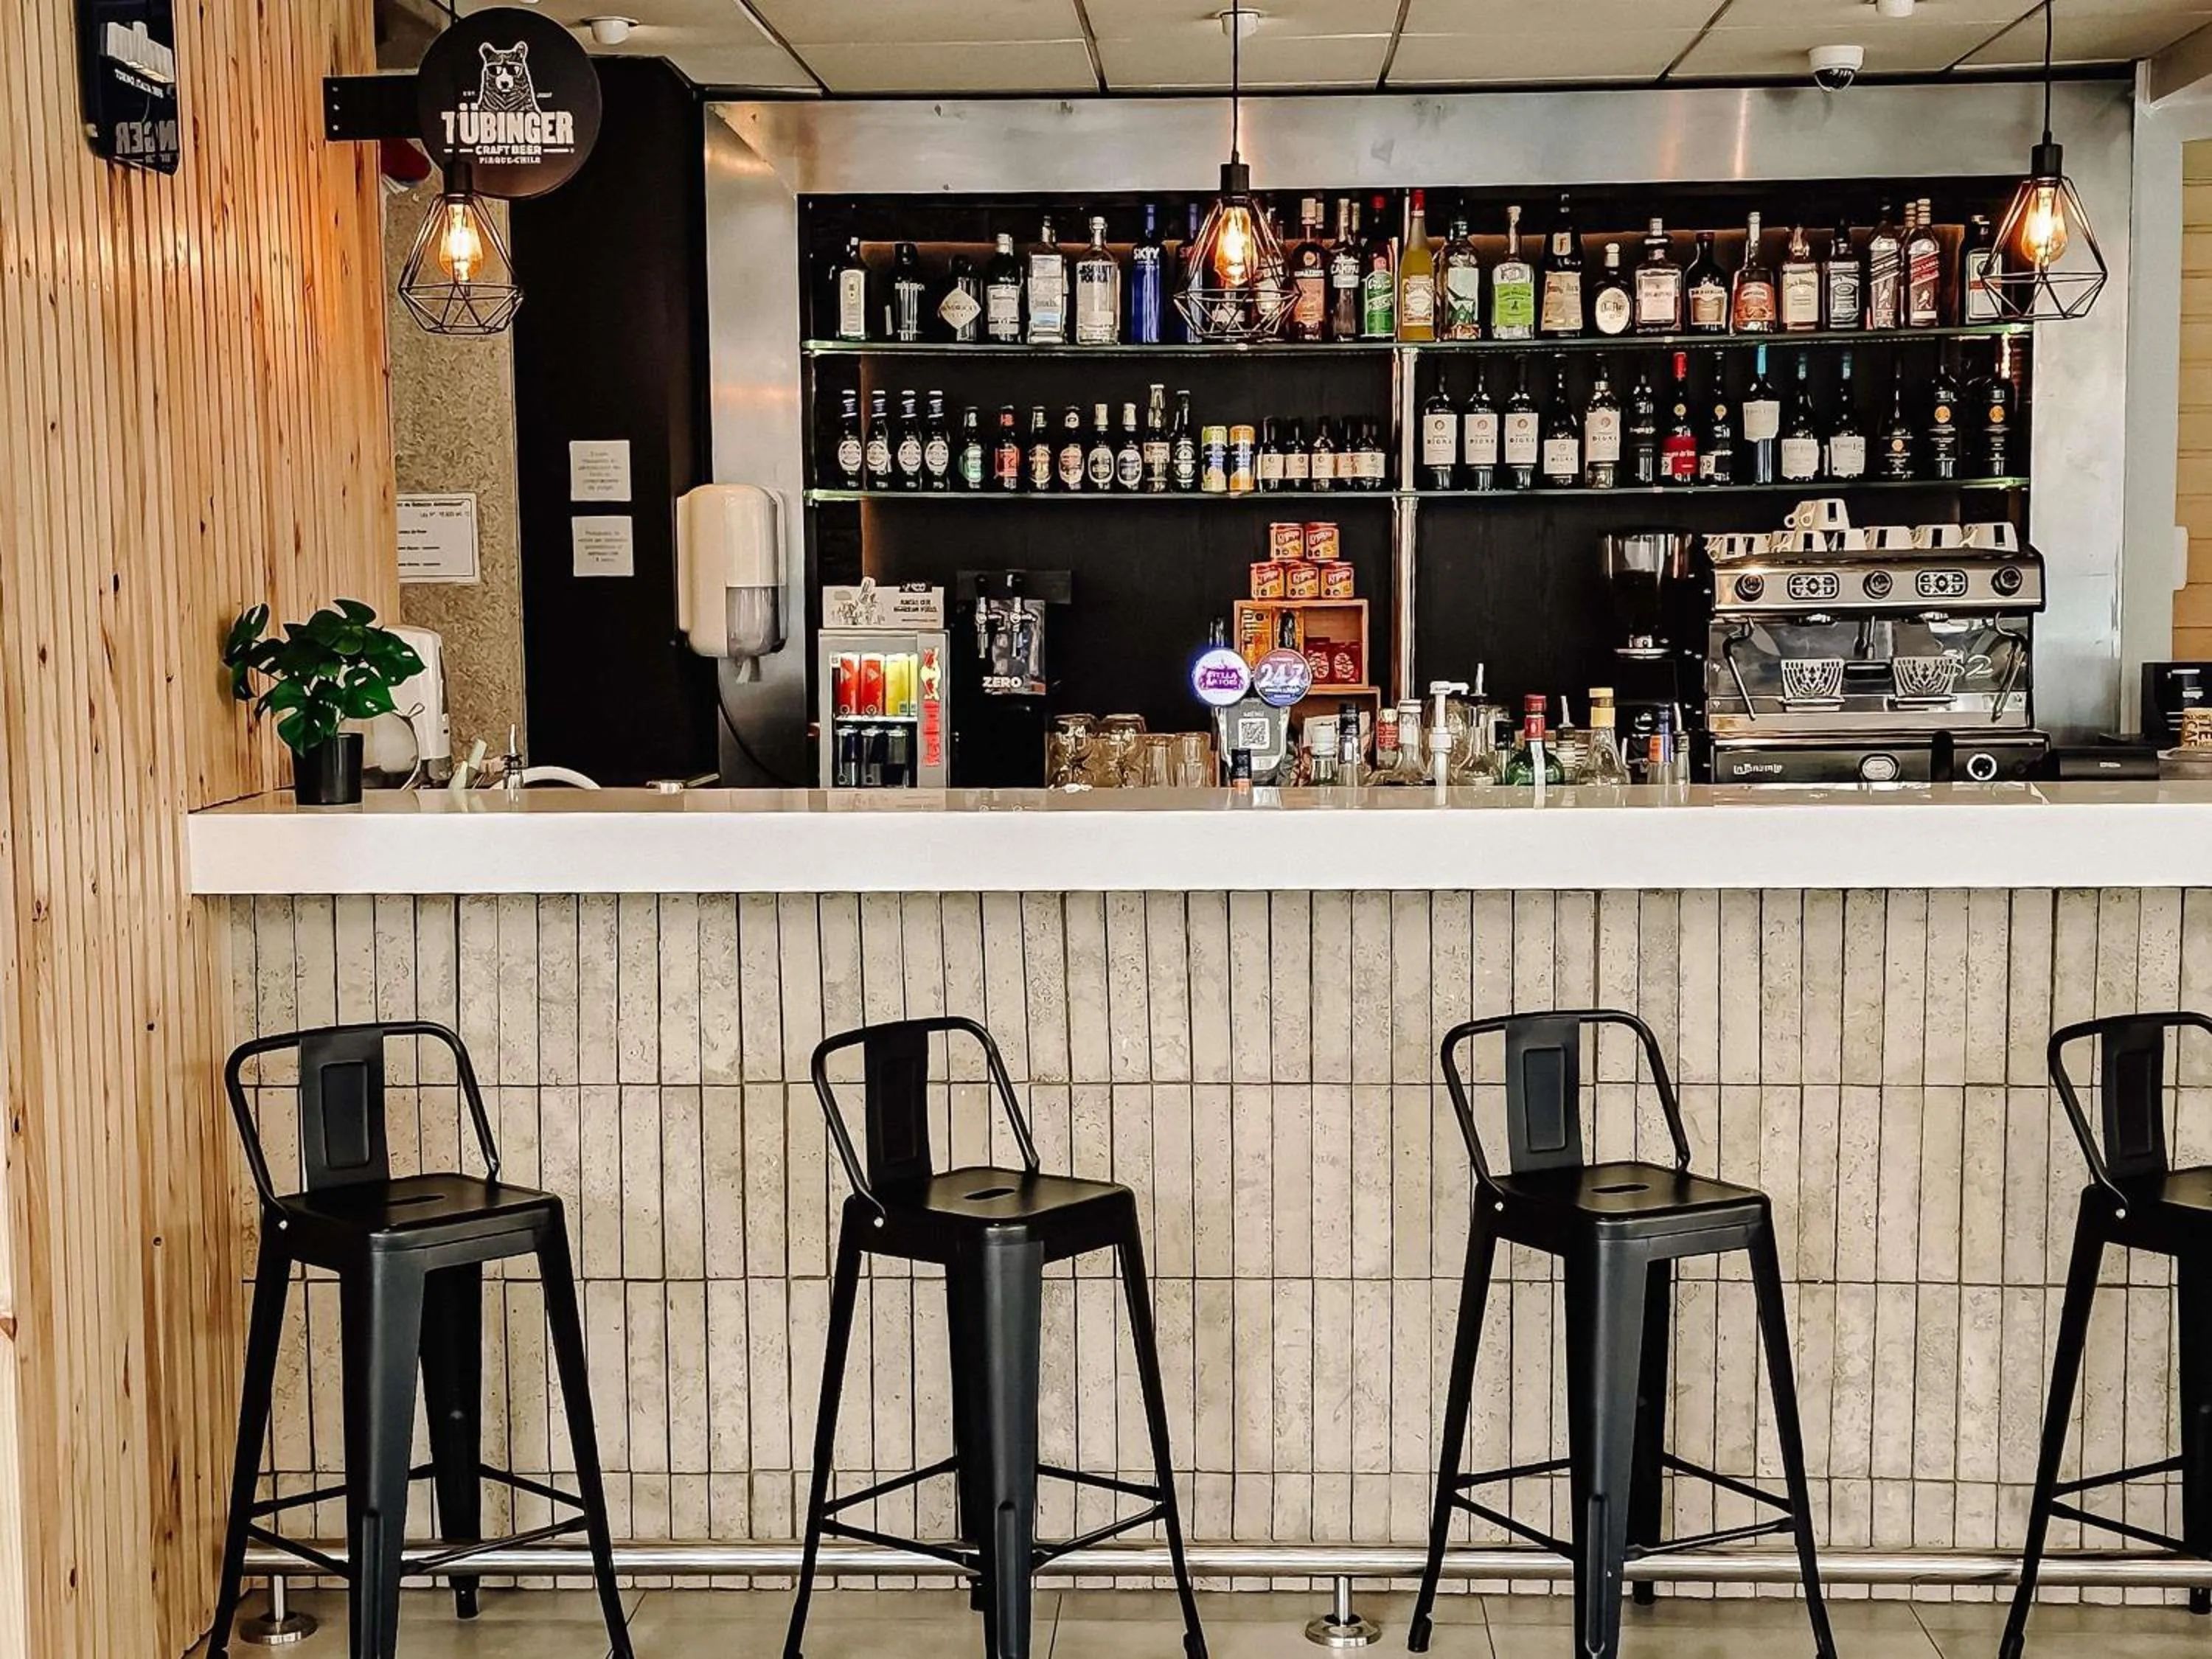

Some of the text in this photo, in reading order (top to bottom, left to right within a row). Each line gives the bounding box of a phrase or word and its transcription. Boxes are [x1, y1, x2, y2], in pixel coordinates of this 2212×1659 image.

[441, 102, 574, 145] TÜBINGER
[476, 145, 542, 155] CRAFT BEER
[1133, 246, 1160, 260] SKYY
[1206, 670, 1237, 680] STELLA
[981, 676, 1023, 688] ZERO
